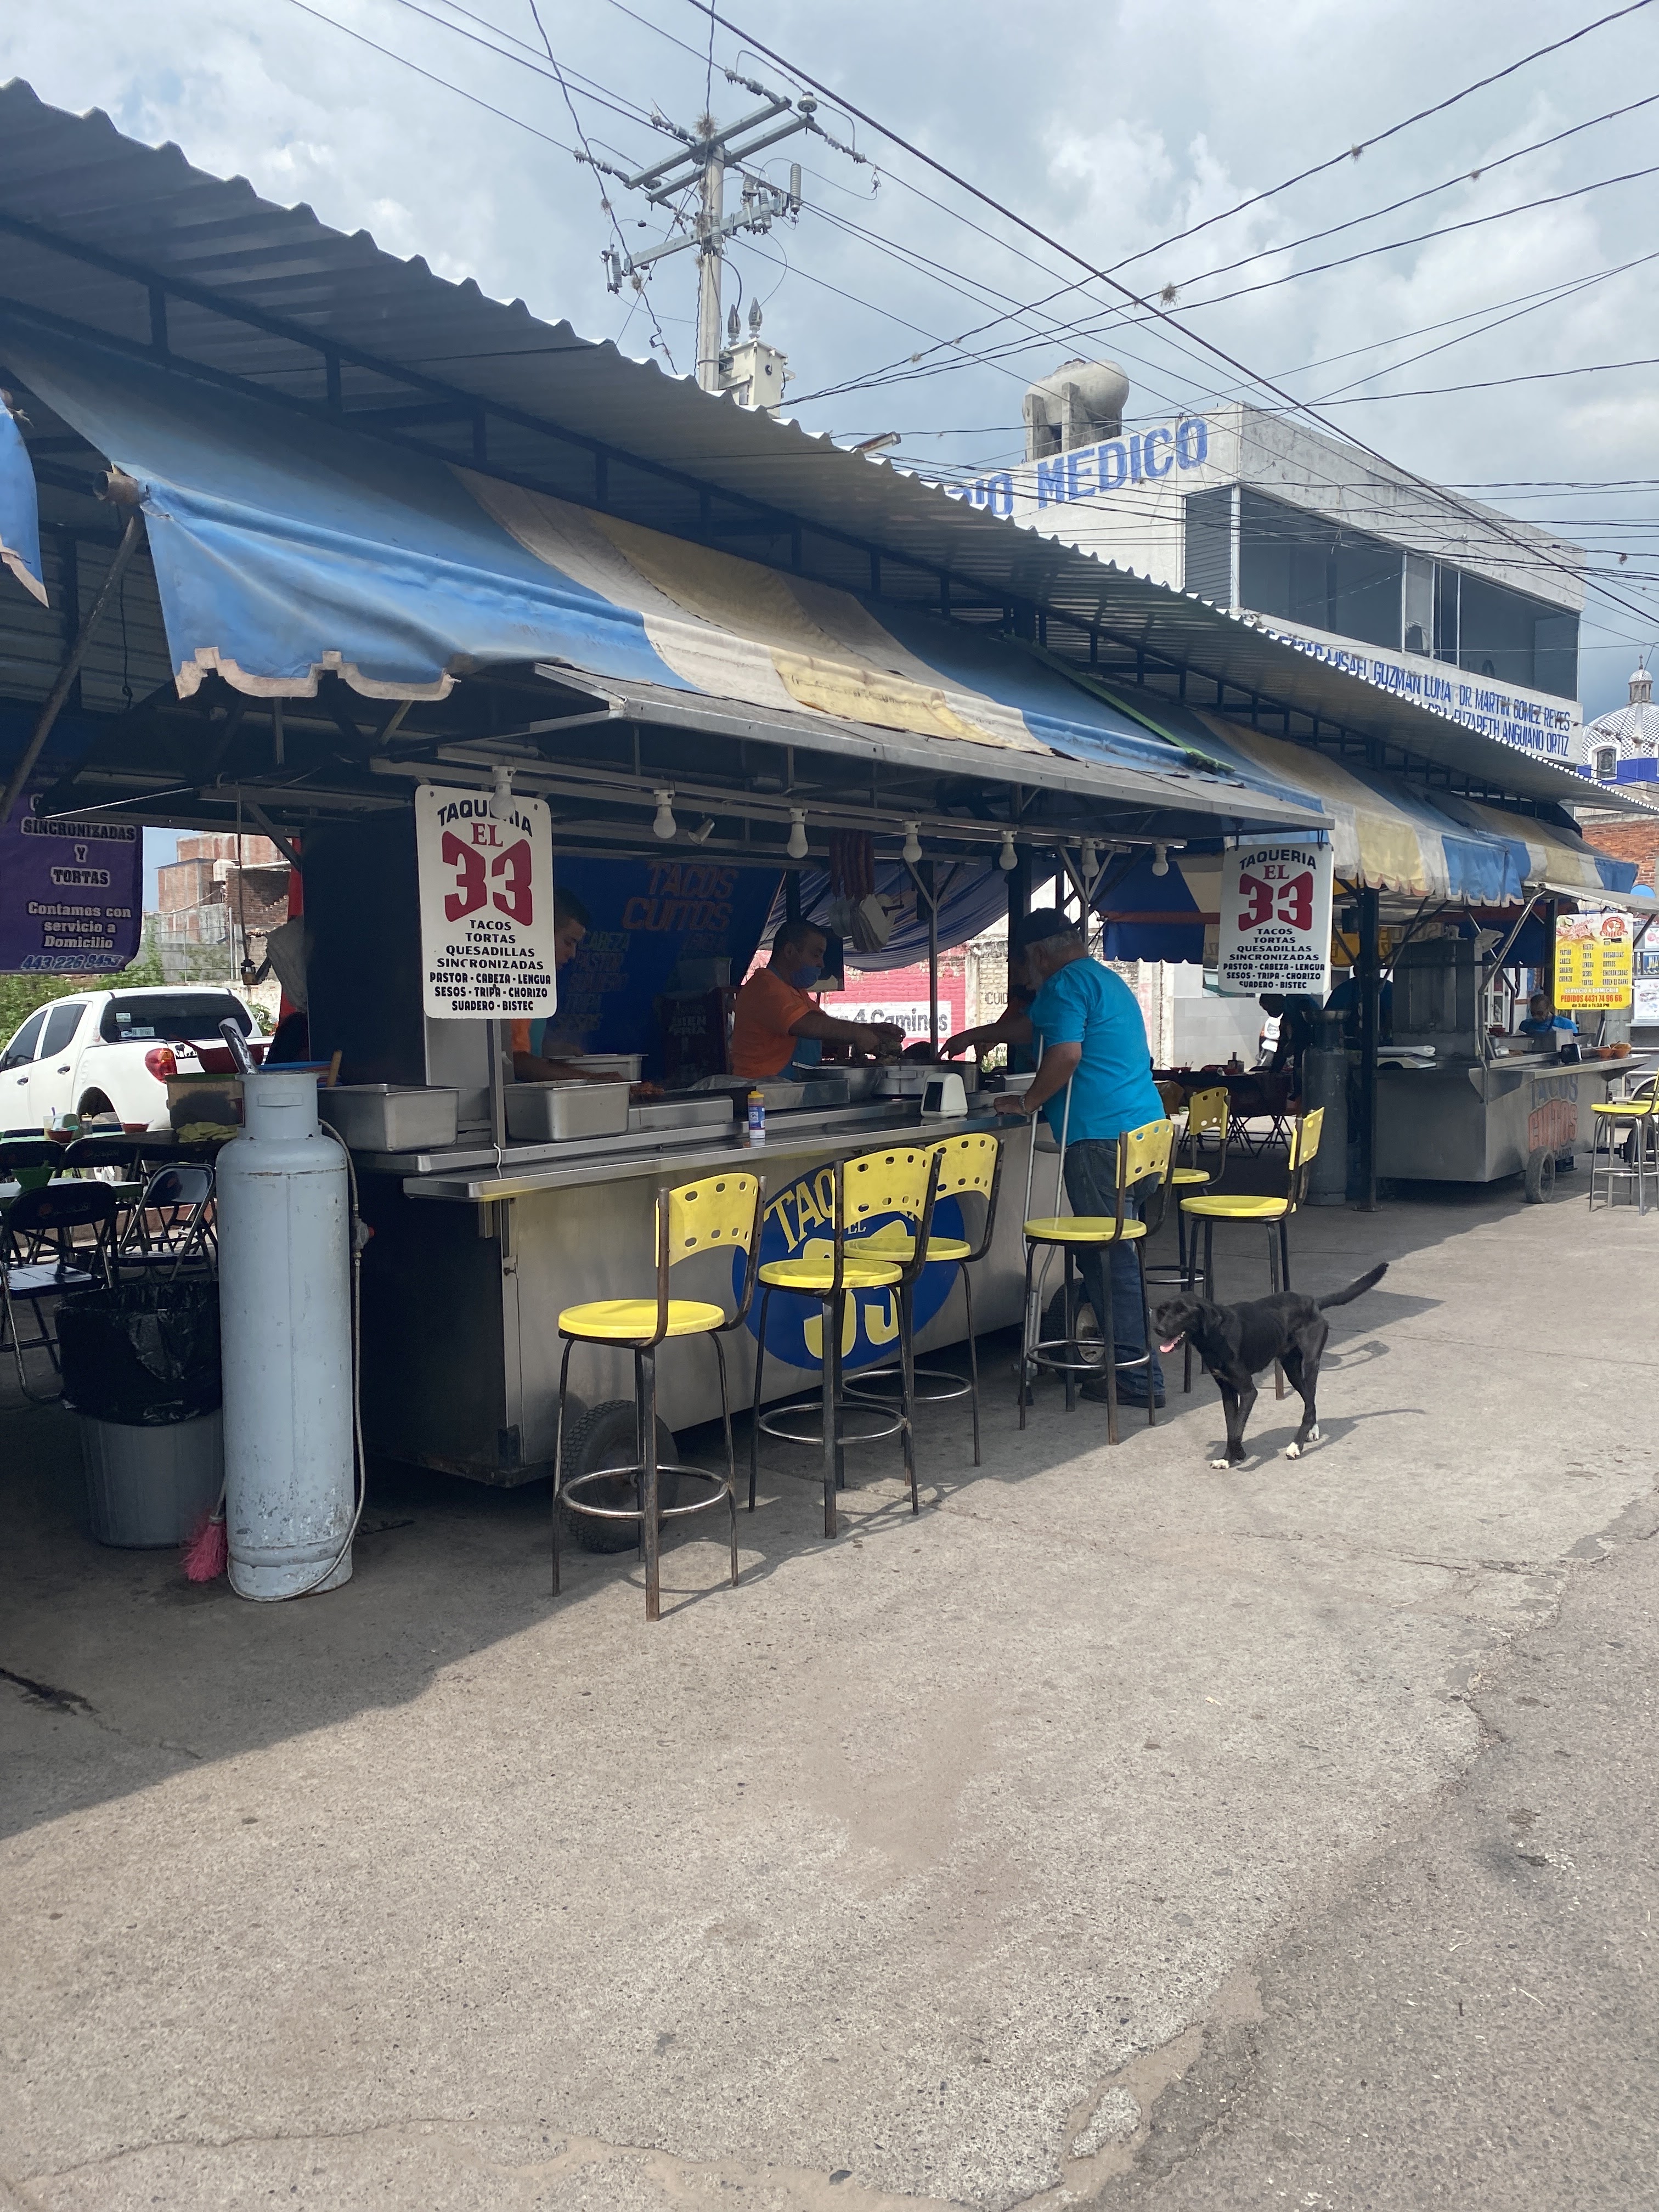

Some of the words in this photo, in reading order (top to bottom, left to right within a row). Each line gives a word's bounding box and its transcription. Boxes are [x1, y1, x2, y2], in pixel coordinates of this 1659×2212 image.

[1037, 417, 1206, 509] MEDICO
[1374, 661, 1420, 694] GUZMAN
[1425, 674, 1451, 702] LUNA
[1459, 685, 1472, 708] DR.
[1476, 689, 1509, 716] MARTIN
[1514, 699, 1541, 725] GOMEZ
[1544, 707, 1570, 731] REYES
[1503, 720, 1544, 751] ANGUIANO
[1547, 732, 1569, 757] ORTIZ
[22, 817, 136, 841] SINCRONIZADAS
[471, 822, 504, 847] EL
[76, 845, 86, 861] Y
[1239, 849, 1317, 870] TAQUERIA
[52, 868, 109, 886] TORTAS
[442, 831, 533, 926] 33
[646, 862, 738, 899] TACOS
[1263, 865, 1289, 879] EL
[28, 901, 101, 916] Contamos
[106, 907, 131, 918] con
[1238, 871, 1313, 931] 33
[621, 896, 733, 931] CUITOS
[44, 920, 103, 933] servicio
[107, 923, 116, 933] a
[470, 919, 511, 930] TACOS
[44, 935, 113, 949] Domicilio
[465, 933, 516, 944] TORTAS
[446, 945, 535, 957] QUESADILLAS
[54, 956, 86, 969] 226
[437, 958, 544, 970] SINCRONIZADAS
[430, 972, 468, 983] PASTOR
[476, 973, 510, 984] CABEZA
[518, 974, 551, 984] LENGUA
[435, 986, 466, 997] SESOS
[474, 987, 500, 997] TRIPA
[509, 988, 548, 997] CHORIZO
[452, 1001, 494, 1011] SUADERO
[503, 1001, 533, 1011] BISTEC
[871, 1008, 948, 1031] Camins
